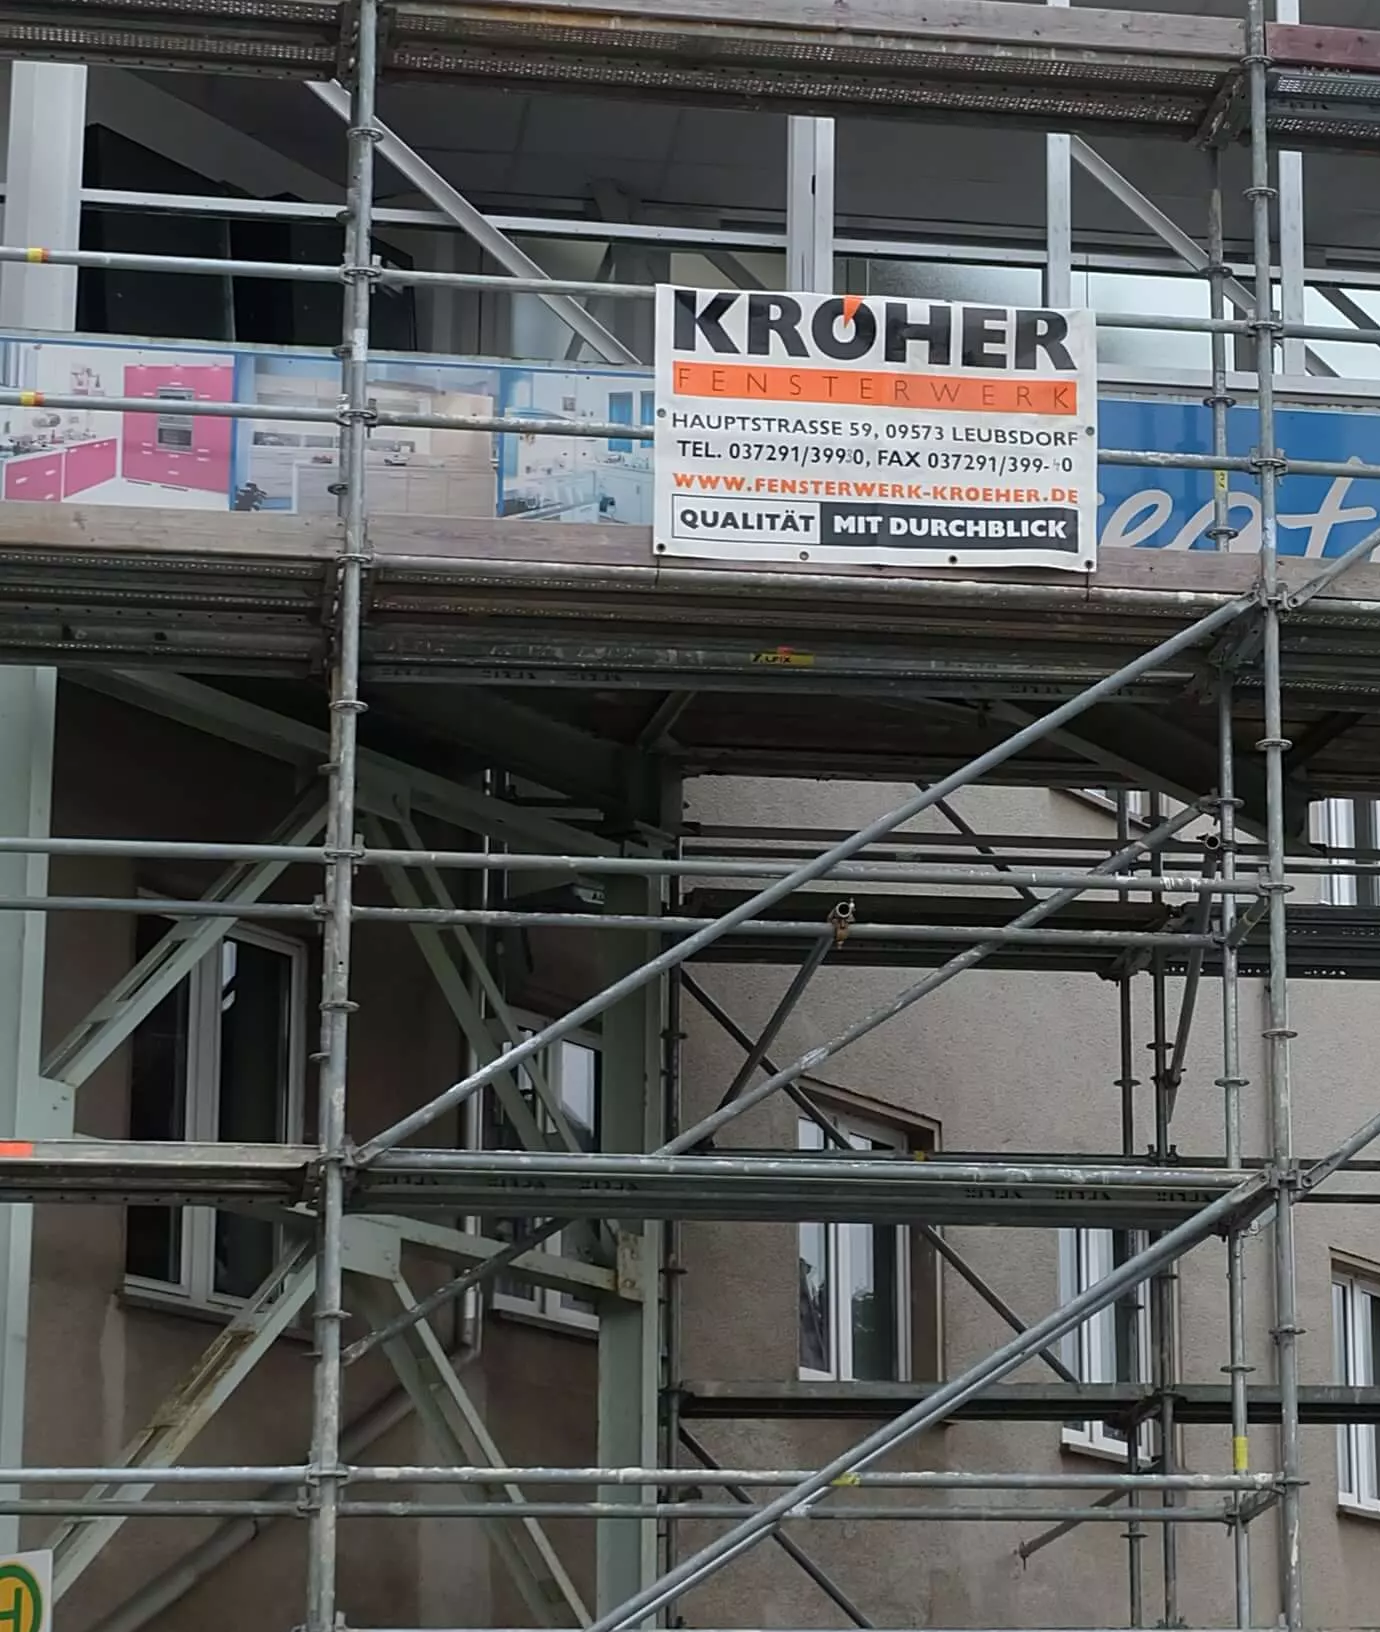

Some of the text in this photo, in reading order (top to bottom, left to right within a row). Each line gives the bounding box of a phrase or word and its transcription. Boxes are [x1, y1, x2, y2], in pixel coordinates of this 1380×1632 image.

[678, 369, 1069, 409] FENSTERWERK
[672, 413, 1078, 446] HAUPTSTRASSE 59, 09573 LEUBSDORF
[677, 440, 722, 459] TEL.
[878, 449, 921, 468] FAX
[673, 472, 1079, 504] WWW.FENSTERWERK-KROEHER.DE
[680, 508, 1067, 539] QUALITÄT MIT DURCHBLICK
